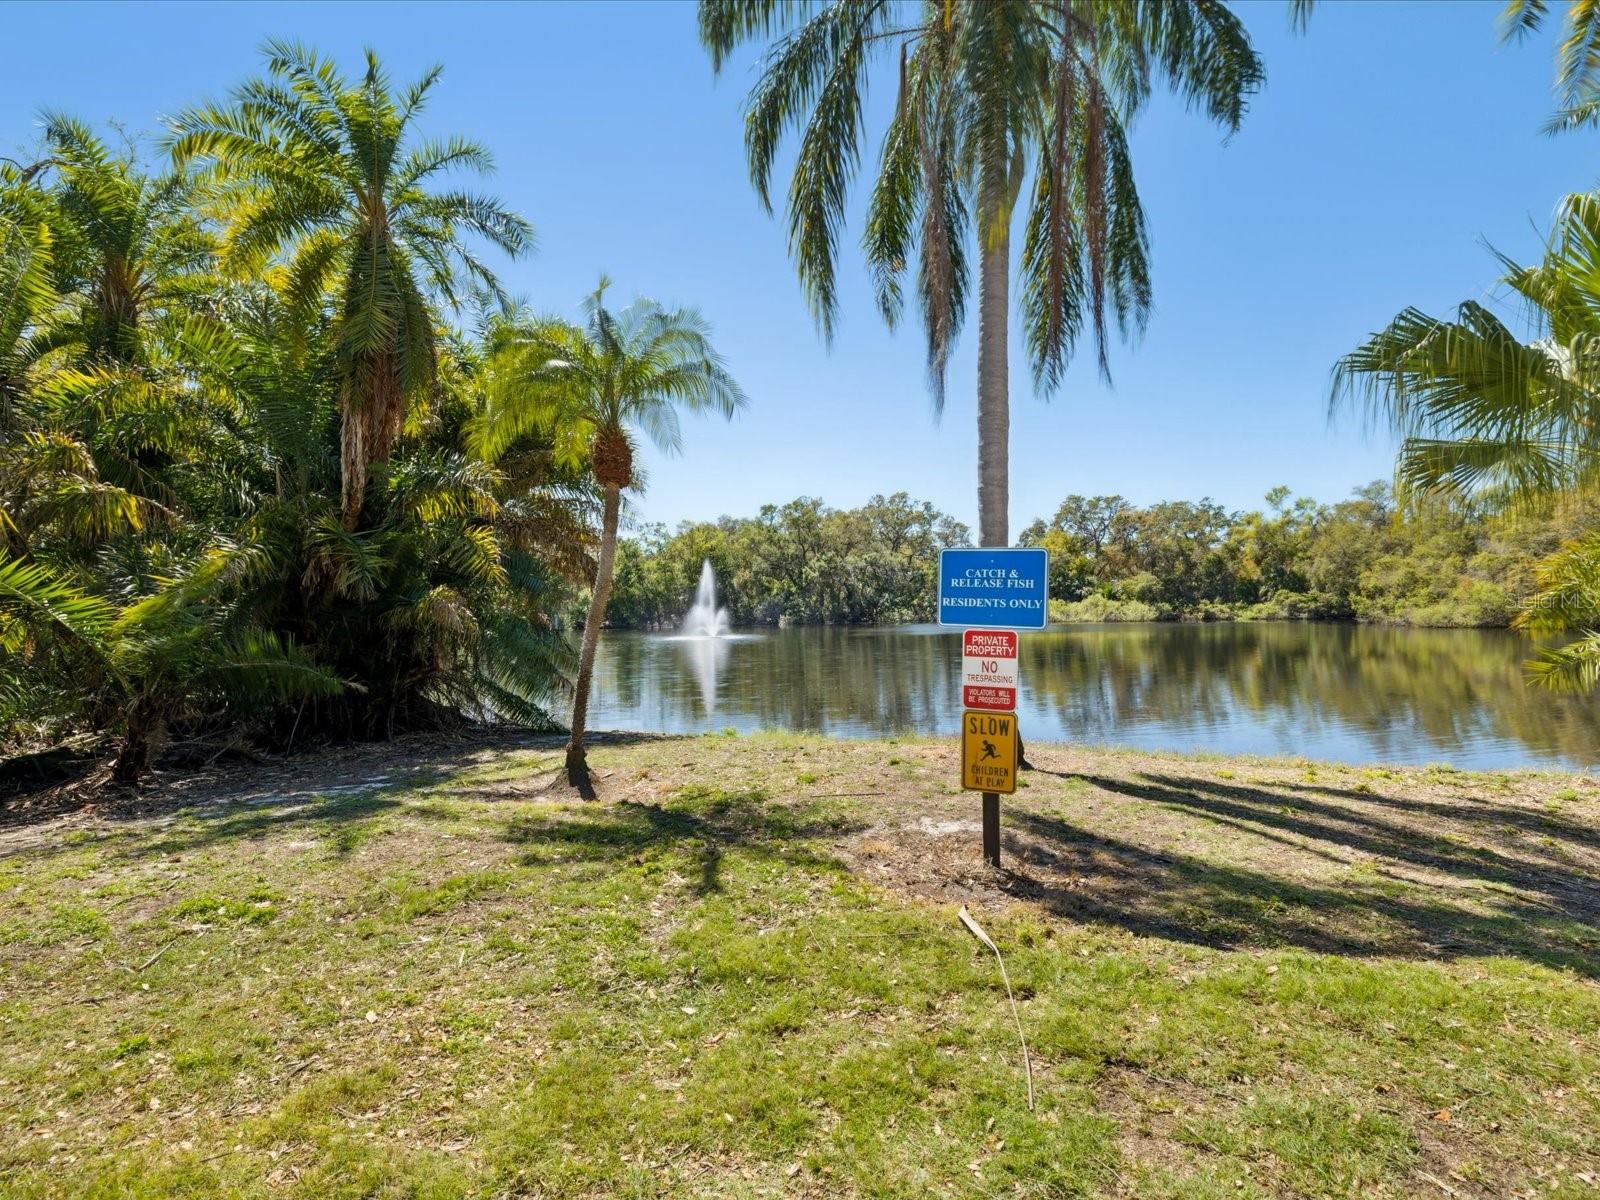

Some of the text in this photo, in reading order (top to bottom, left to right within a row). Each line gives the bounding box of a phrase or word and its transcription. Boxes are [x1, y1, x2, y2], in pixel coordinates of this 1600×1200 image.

[965, 569, 1018, 578] CATCH &
[951, 579, 1034, 588] RELEASE FISH
[942, 597, 1042, 609] RESIDENTS ONLY
[972, 635, 1008, 646] PRIVATE
[966, 645, 1014, 656] PROPERTY
[982, 661, 998, 673] NO
[967, 674, 1013, 683] TRESPASSING
[968, 689, 996, 697] VIOLATORS
[970, 716, 1009, 736] SLOW
[971, 764, 1009, 776] CHILDREN
[975, 777, 1005, 787] AT PLAY
